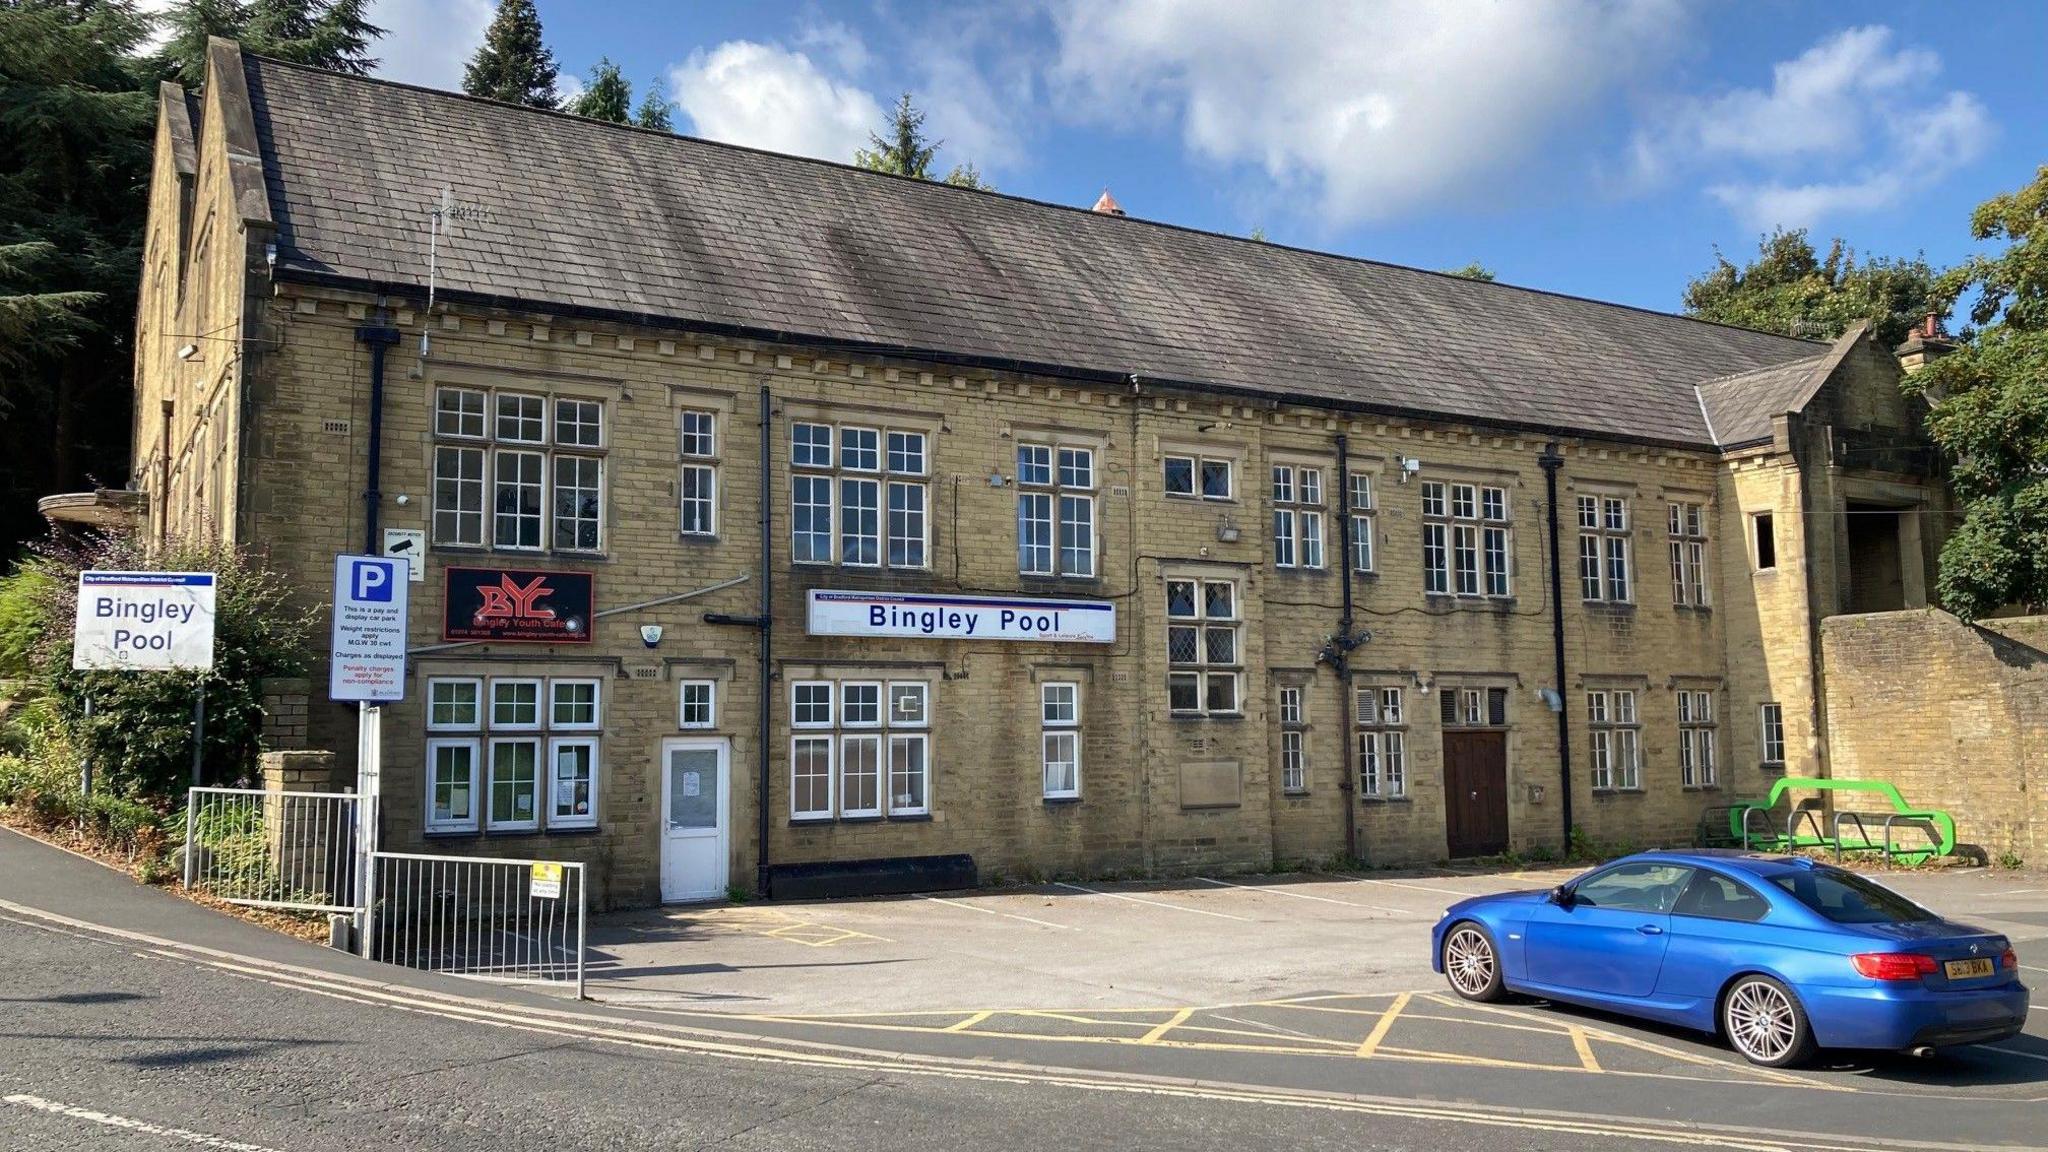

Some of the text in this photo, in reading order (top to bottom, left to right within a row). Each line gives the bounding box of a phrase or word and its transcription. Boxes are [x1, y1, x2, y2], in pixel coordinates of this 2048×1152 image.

[359, 564, 385, 598] P
[474, 572, 556, 618] BYC
[96, 597, 194, 624] Bingley
[474, 618, 510, 627] Bingley
[513, 619, 541, 628] Youth
[870, 605, 1058, 634] Bingley Pool
[114, 629, 172, 650] Pool
